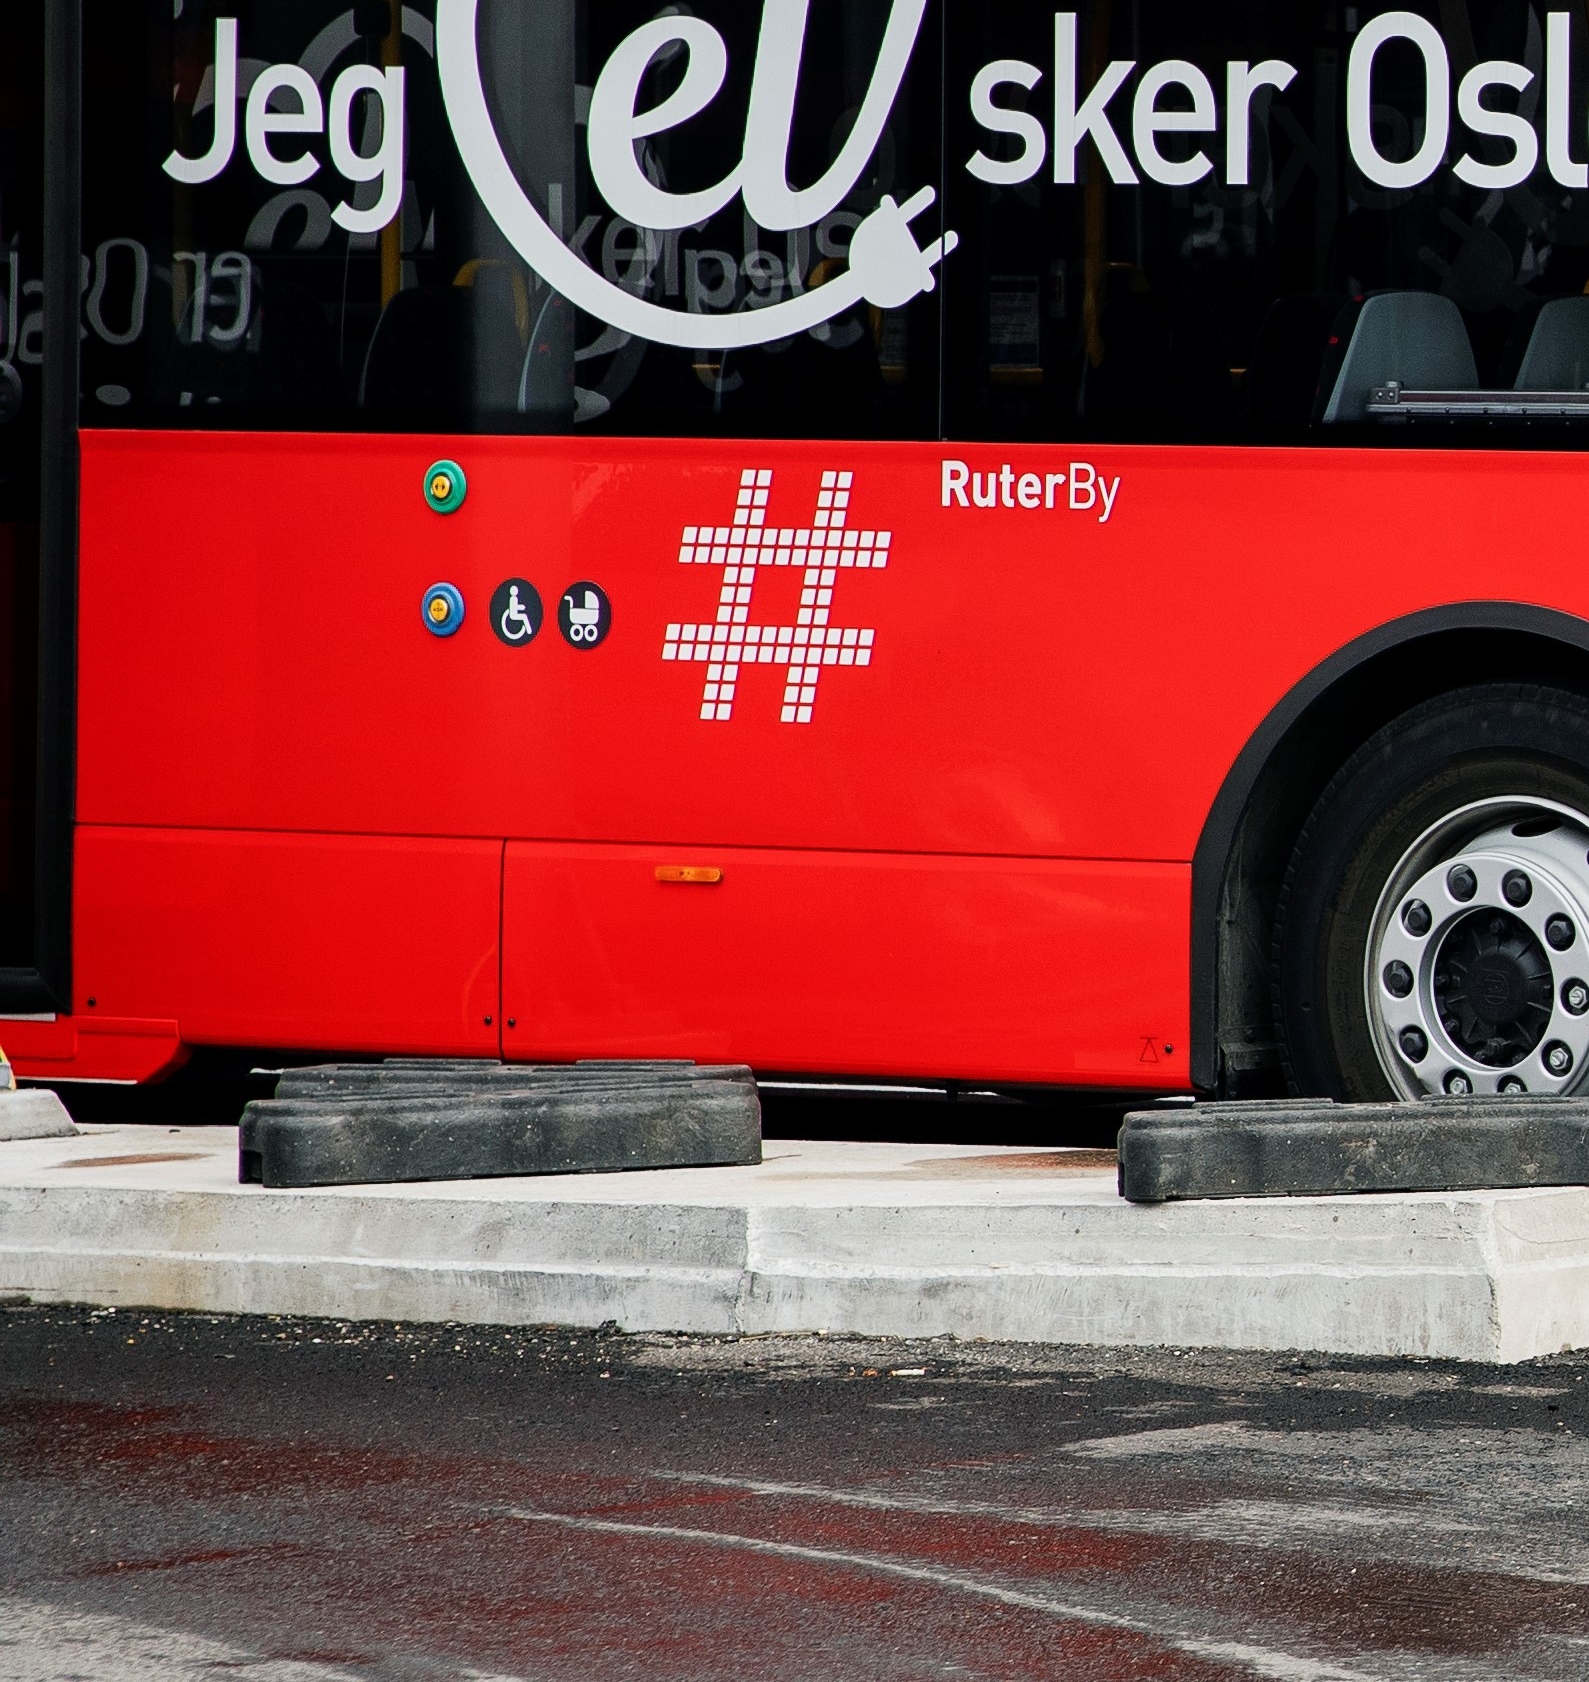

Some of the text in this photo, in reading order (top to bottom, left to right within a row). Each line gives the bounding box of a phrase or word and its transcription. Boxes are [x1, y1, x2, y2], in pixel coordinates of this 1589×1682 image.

[161, 16, 406, 234] Jeg
[965, 11, 1298, 187] sker
[940, 459, 1122, 522] RuterBy
